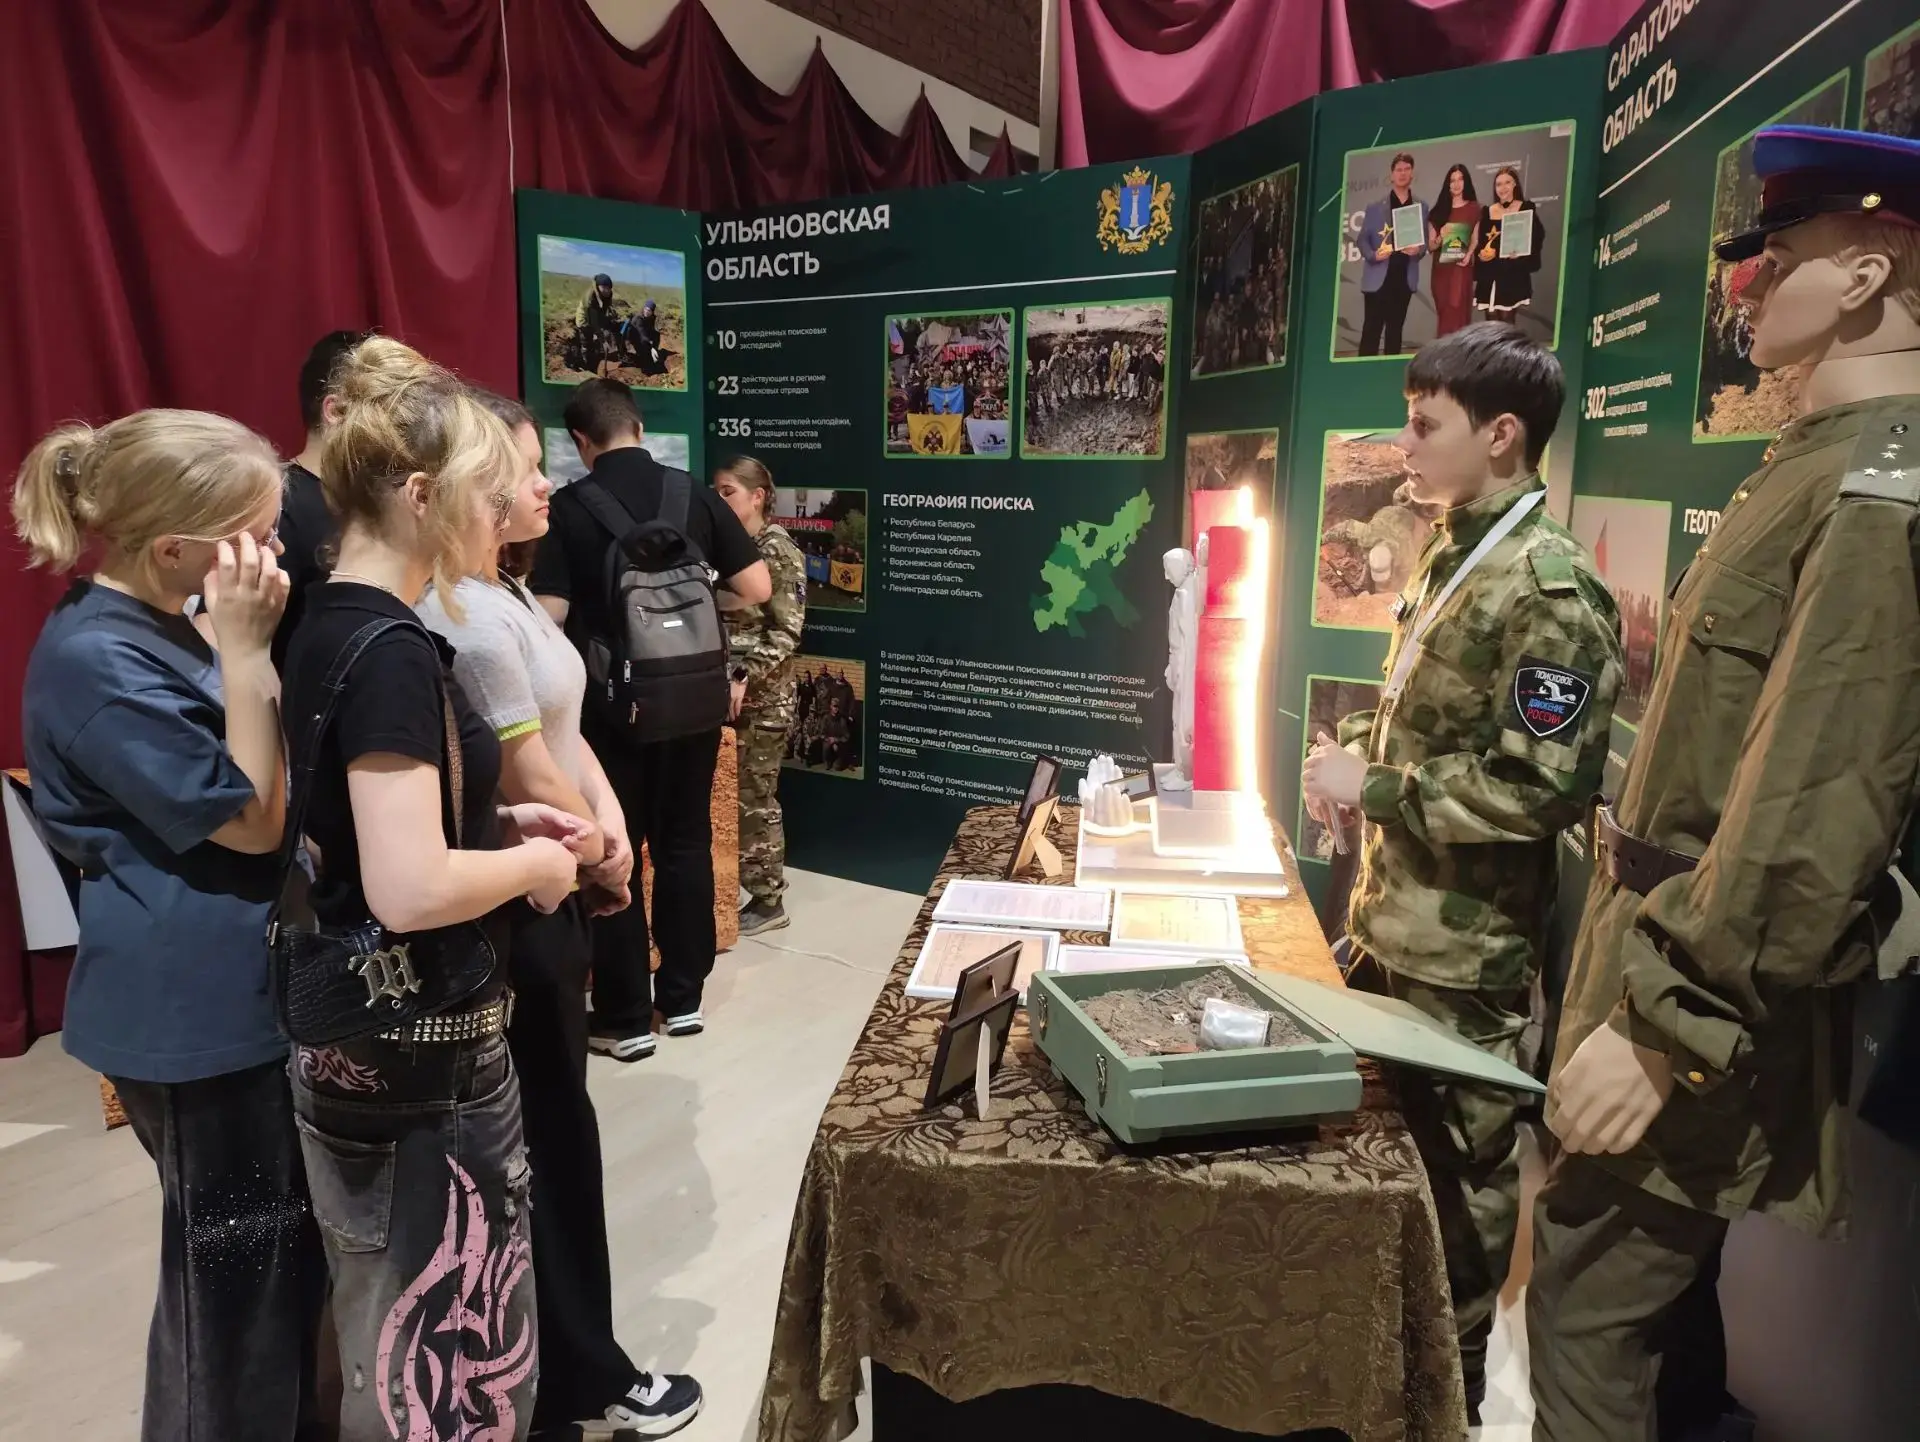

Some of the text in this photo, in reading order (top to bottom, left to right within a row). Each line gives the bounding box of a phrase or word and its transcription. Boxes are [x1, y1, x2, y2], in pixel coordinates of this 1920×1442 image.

[1608, 0, 1700, 91] САРАТОВС
[1602, 58, 1677, 154] ОБЛАСТЬ
[706, 204, 890, 246] УЛЬЯНОВСКАЯ
[1598, 234, 1610, 269] 14
[706, 251, 820, 281] ОБЛАСТЬ
[717, 330, 736, 349] 10
[788, 328, 826, 336] поисковых
[1592, 314, 1604, 347] 15
[718, 376, 739, 395] 23
[742, 376, 789, 384] действующих
[796, 375, 826, 383] регионе
[742, 386, 810, 396] поисковых отрядов
[1585, 386, 1606, 420] 302
[718, 418, 751, 437] 336
[754, 418, 810, 426] представителей
[754, 430, 788, 438] входящих
[793, 441, 822, 450] отрядов
[882, 494, 1034, 511] ГЕОГРАФИЯ ПОИСКА
[778, 519, 826, 532] БЕЛАРУСЬ
[890, 518, 976, 530] Республика Беларусь
[1684, 508, 1720, 535] ГЕОГР
[890, 531, 972, 543] Республика Карелия
[890, 544, 982, 557] Волгоградская область
[890, 558, 976, 570] Воронежская область
[889, 570, 964, 584] Калужская область
[888, 584, 983, 598] Ленинградская область
[880, 650, 886, 658] В
[888, 652, 916, 662] апреле
[916, 655, 934, 664] 2026
[936, 658, 954, 666] года
[955, 658, 1014, 672] Ульяновскими
[1016, 665, 1078, 678] поисковиками
[1088, 672, 1146, 684] агрогородке
[880, 662, 919, 674] Малевичи
[920, 666, 968, 679] Республики
[970, 672, 1008, 683] Беларусь
[1009, 677, 1054, 688] совместно
[1062, 682, 1108, 694] местными
[1110, 688, 1154, 699] властями
[1534, 670, 1574, 686] ПОИСКОВОЕ
[880, 674, 1136, 710] была высажена Аллея Памяти 154-й Ульяновской стрелковой
[880, 686, 913, 696] дивизии
[923, 690, 936, 699] 154
[937, 693, 972, 704] саженца
[980, 698, 1008, 709] память
[1017, 704, 1047, 712] воинах
[1048, 706, 1088, 718] дивизии,
[1090, 711, 1117, 720] также
[1119, 713, 1143, 724] была
[880, 698, 992, 719] установлена памятная доска.
[1528, 697, 1566, 714] ДВИЖЕНИЕ
[1526, 708, 1561, 724] РОССИИ
[880, 720, 890, 728] По
[892, 722, 937, 734] инициативе
[939, 730, 996, 744] региональных
[998, 738, 1052, 750] поисковиков
[1062, 746, 1092, 756] городе
[879, 743, 918, 756] Баталова.
[922, 738, 946, 748] улица
[947, 741, 970, 751] Героя
[972, 744, 1018, 758] Советского
[878, 766, 900, 776] Всего
[908, 770, 926, 780] 2026
[927, 774, 944, 784] году
[946, 778, 1004, 792] поисковиками
[878, 778, 920, 790] проведено
[921, 784, 944, 794] более
[946, 788, 967, 799] 20-ти
[968, 792, 1012, 806] поисковых
